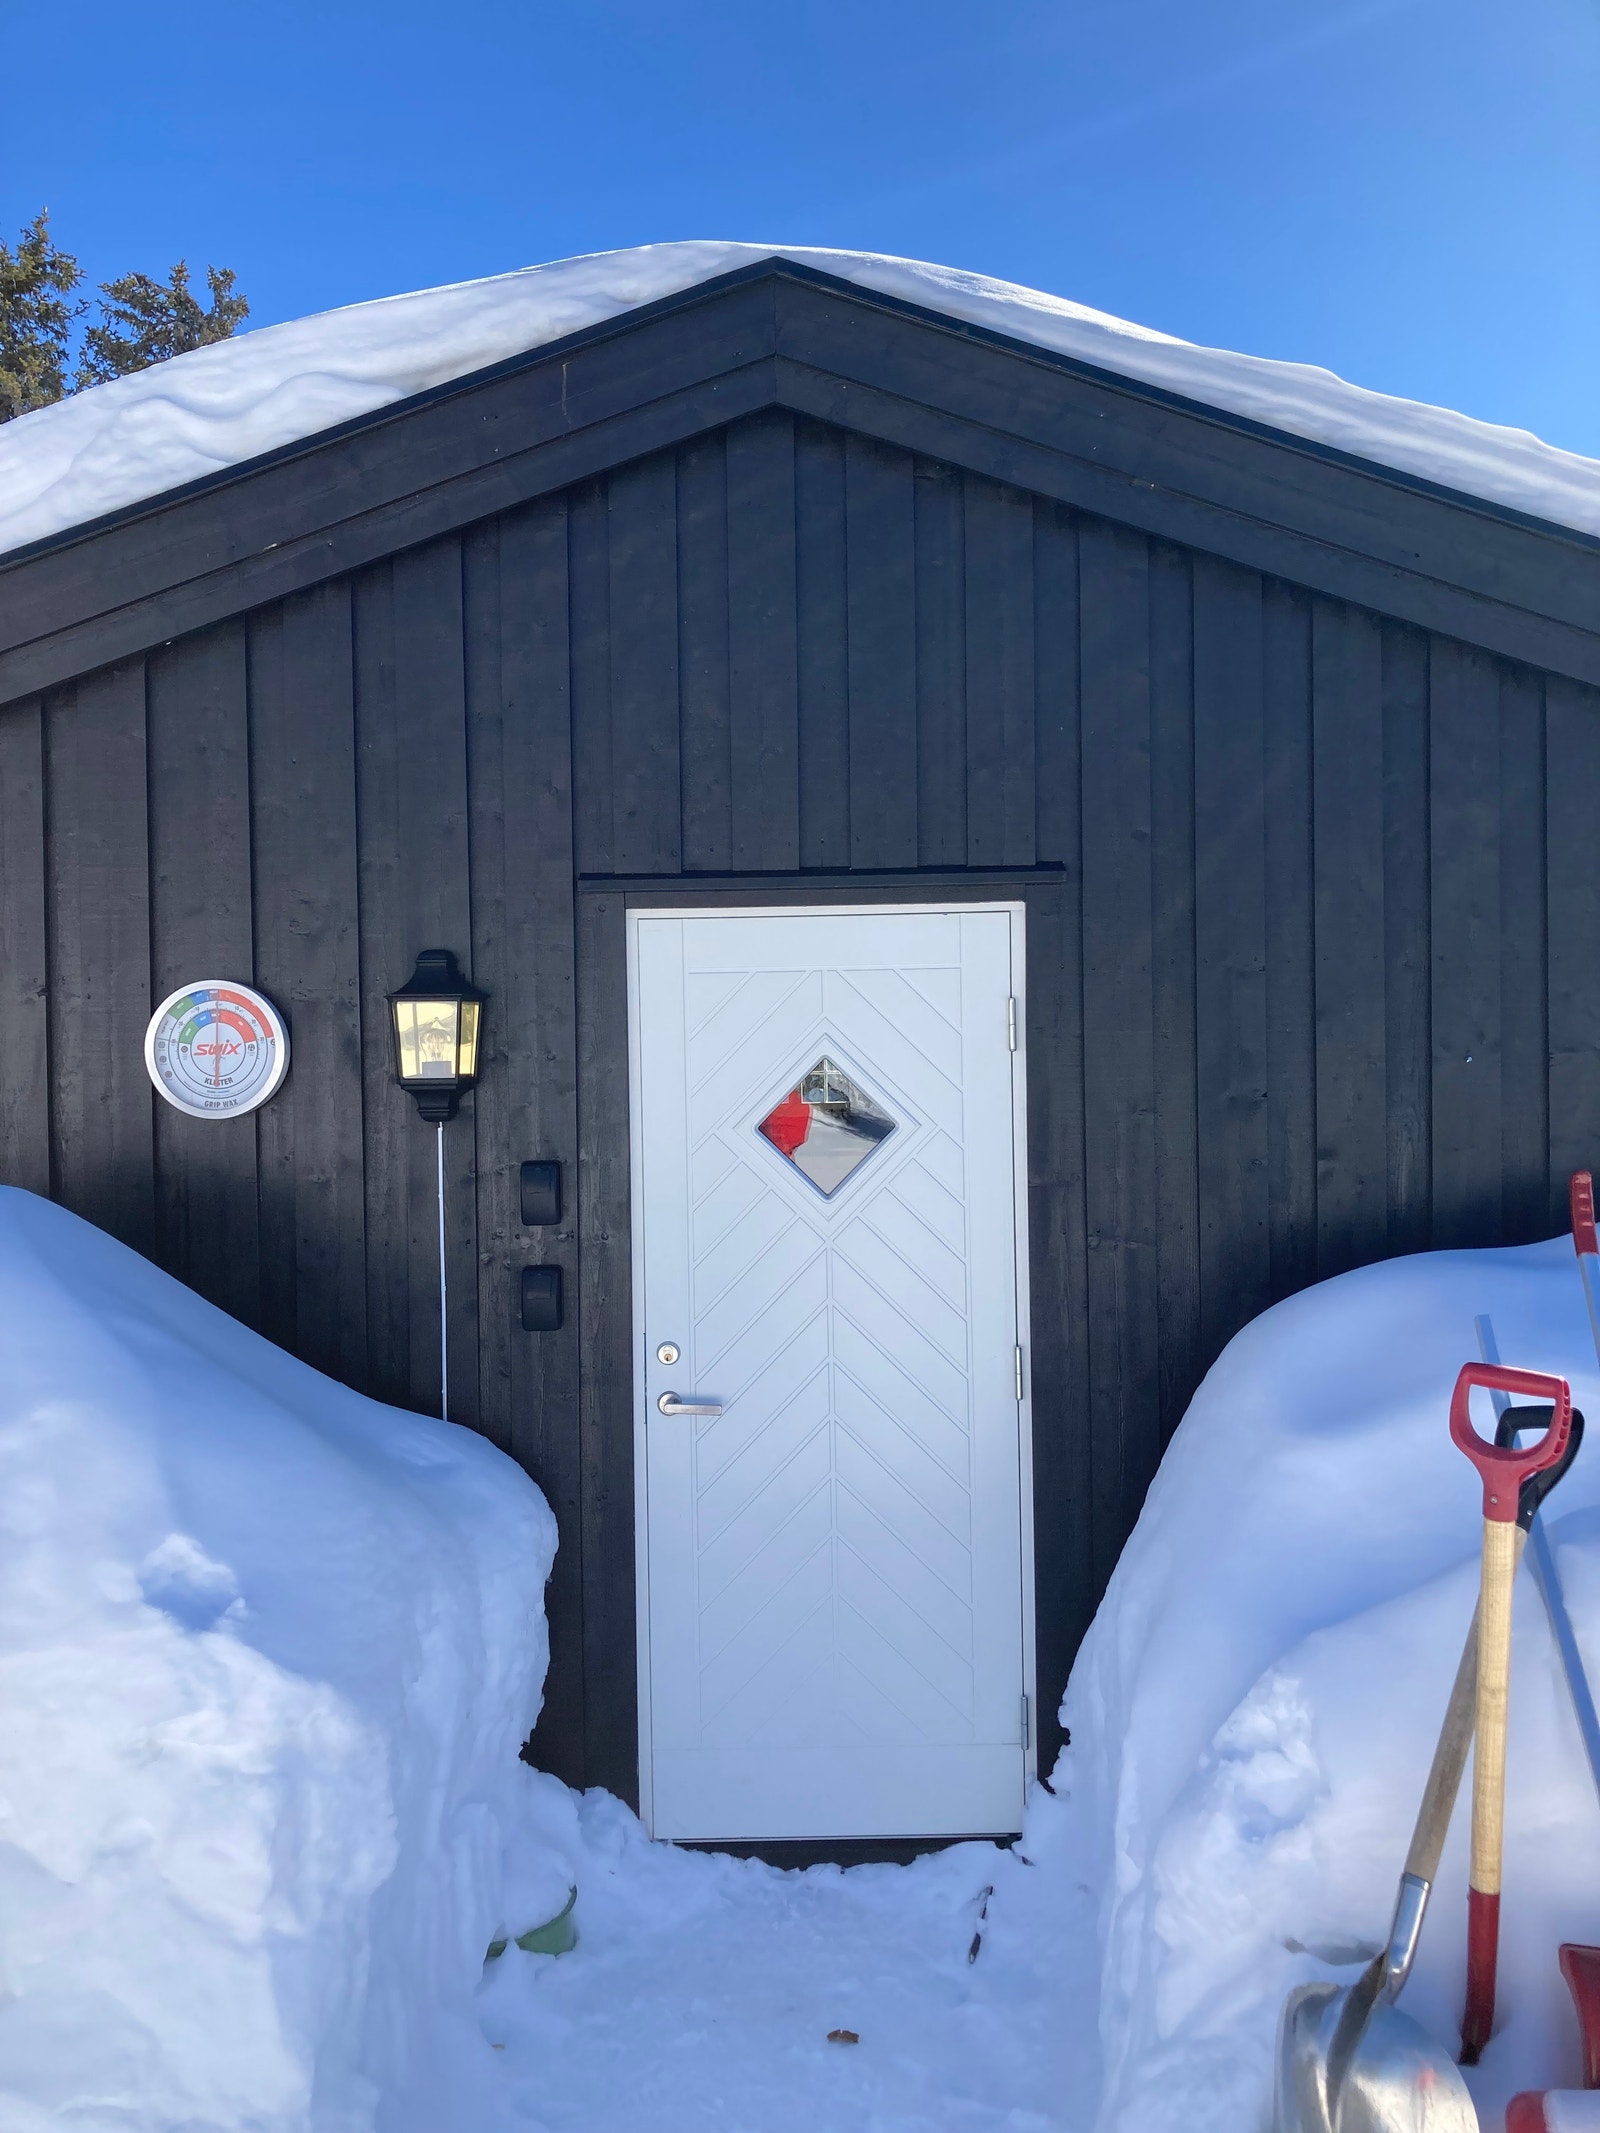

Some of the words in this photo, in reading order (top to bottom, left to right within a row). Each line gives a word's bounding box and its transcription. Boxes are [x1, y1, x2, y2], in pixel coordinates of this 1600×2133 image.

[204, 1077, 234, 1086] KLTER
[204, 1100, 220, 1109] GRIP
[222, 1099, 238, 1108] WAX
